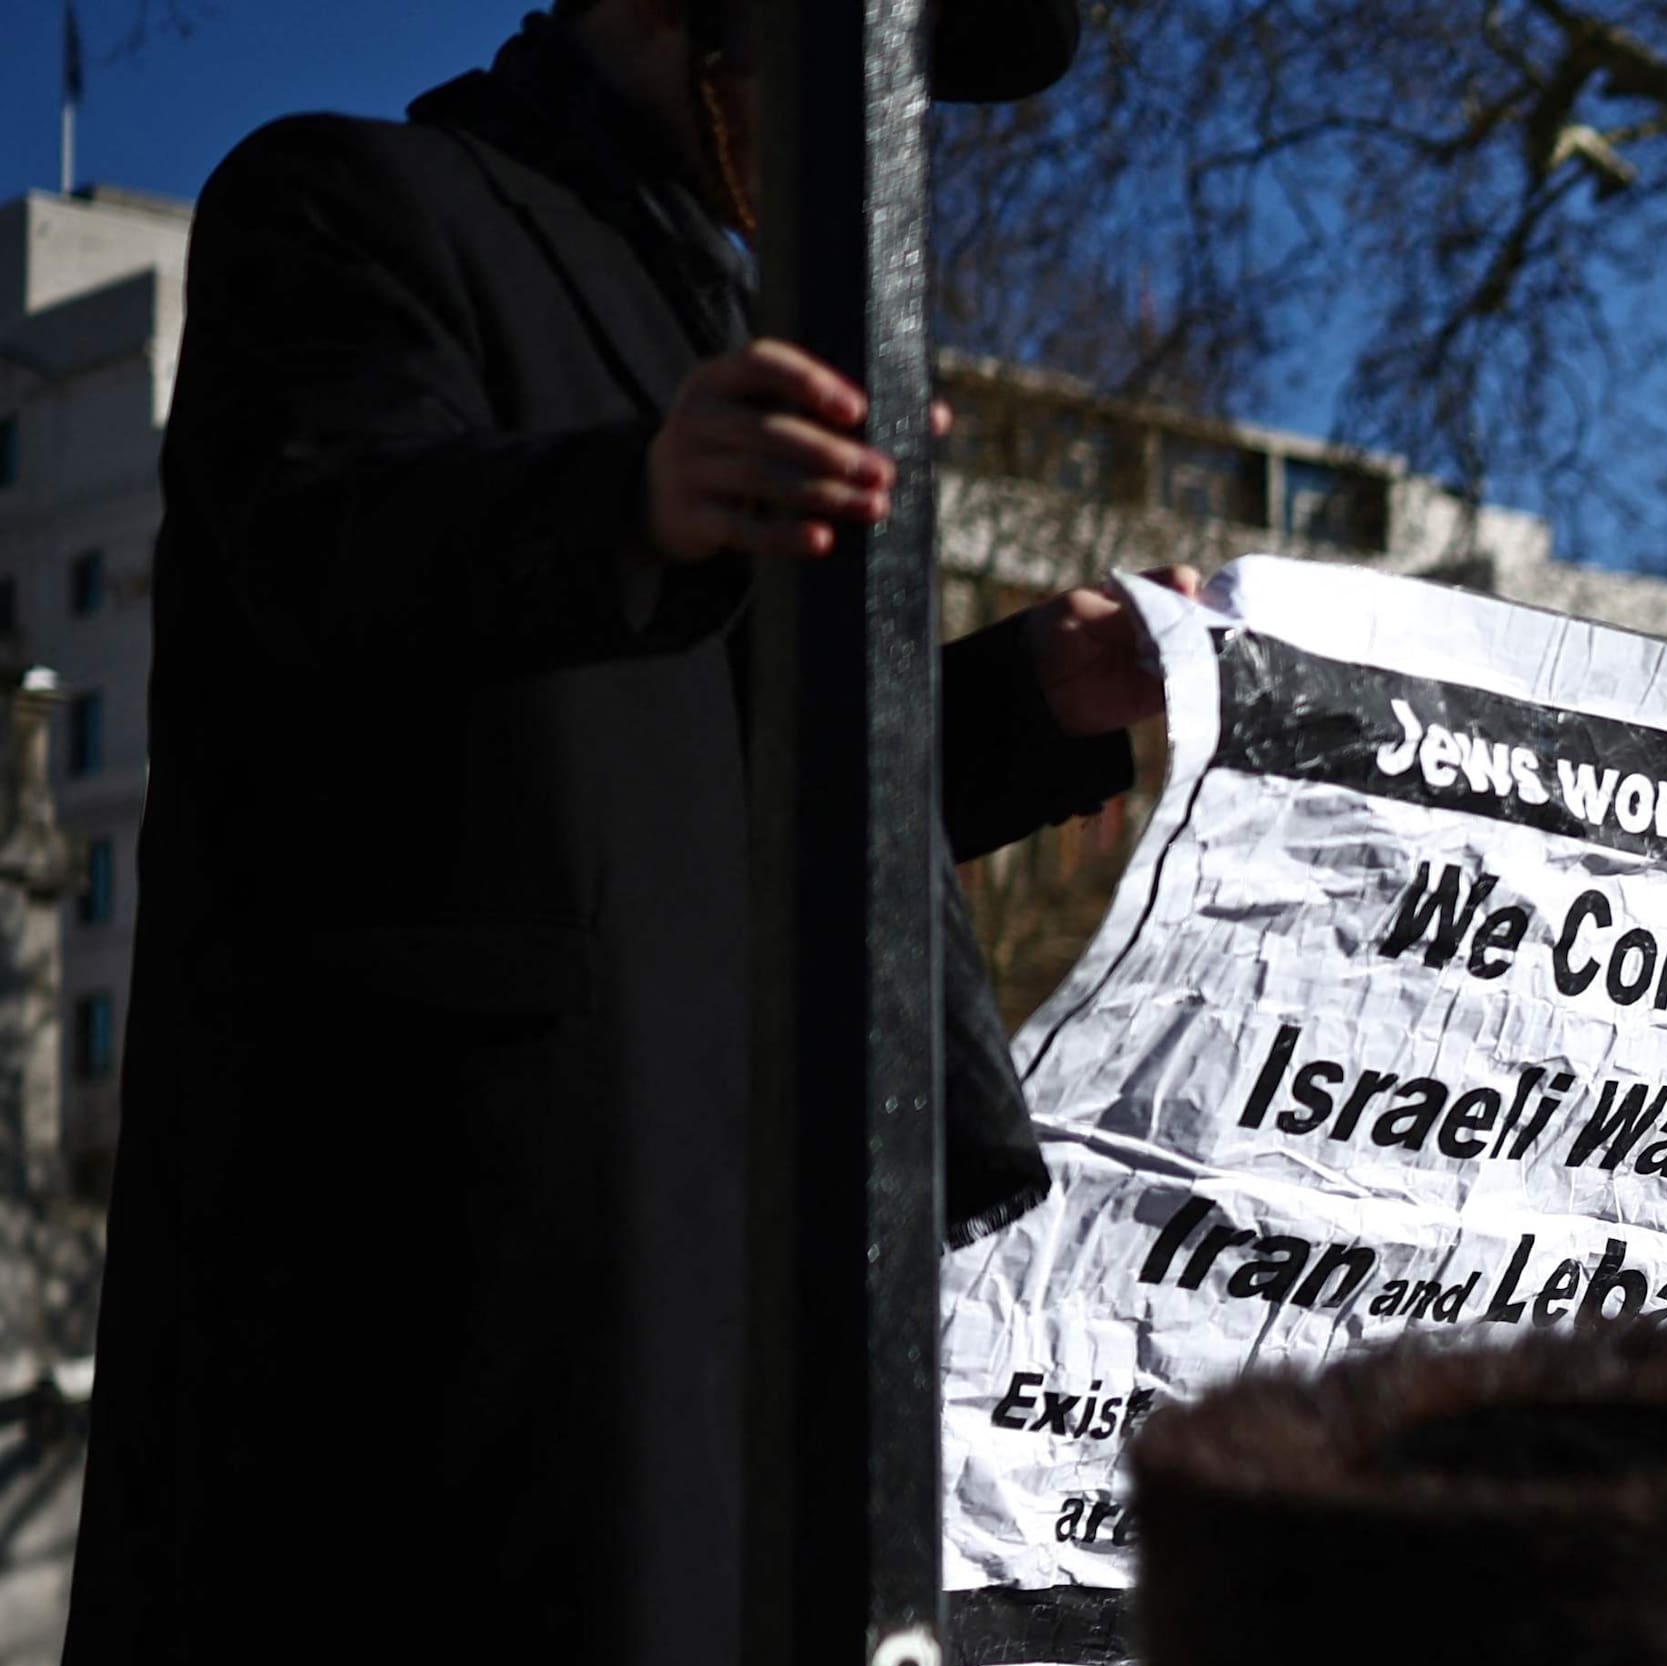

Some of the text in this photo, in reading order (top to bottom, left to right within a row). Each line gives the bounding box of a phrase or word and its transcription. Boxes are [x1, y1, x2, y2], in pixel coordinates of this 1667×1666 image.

[1376, 699, 1551, 805] Jews
[1378, 859, 1529, 981] We
[1237, 1025, 1576, 1161] Israeli
[1138, 1195, 1377, 1310] Iran
[1368, 1270, 1481, 1325] and
